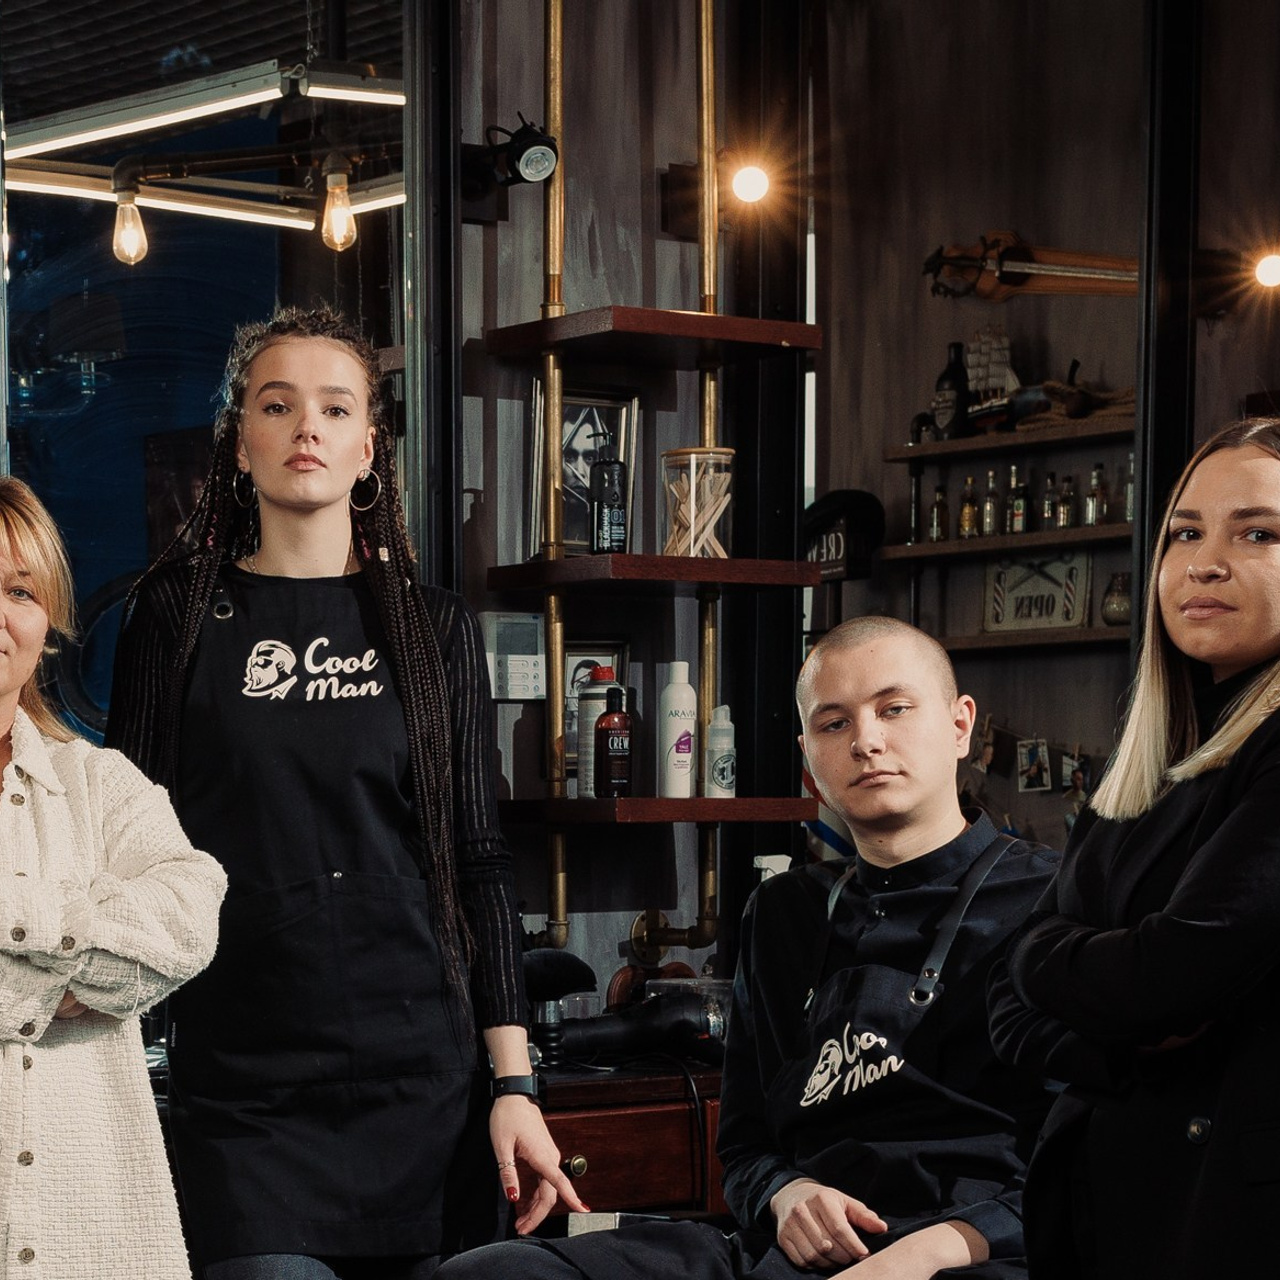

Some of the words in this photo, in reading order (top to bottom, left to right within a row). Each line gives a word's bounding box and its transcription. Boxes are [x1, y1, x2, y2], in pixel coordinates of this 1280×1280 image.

[304, 637, 380, 674] Cool
[305, 676, 384, 701] Man
[608, 736, 630, 750] CREW
[842, 1055, 905, 1096] Man
